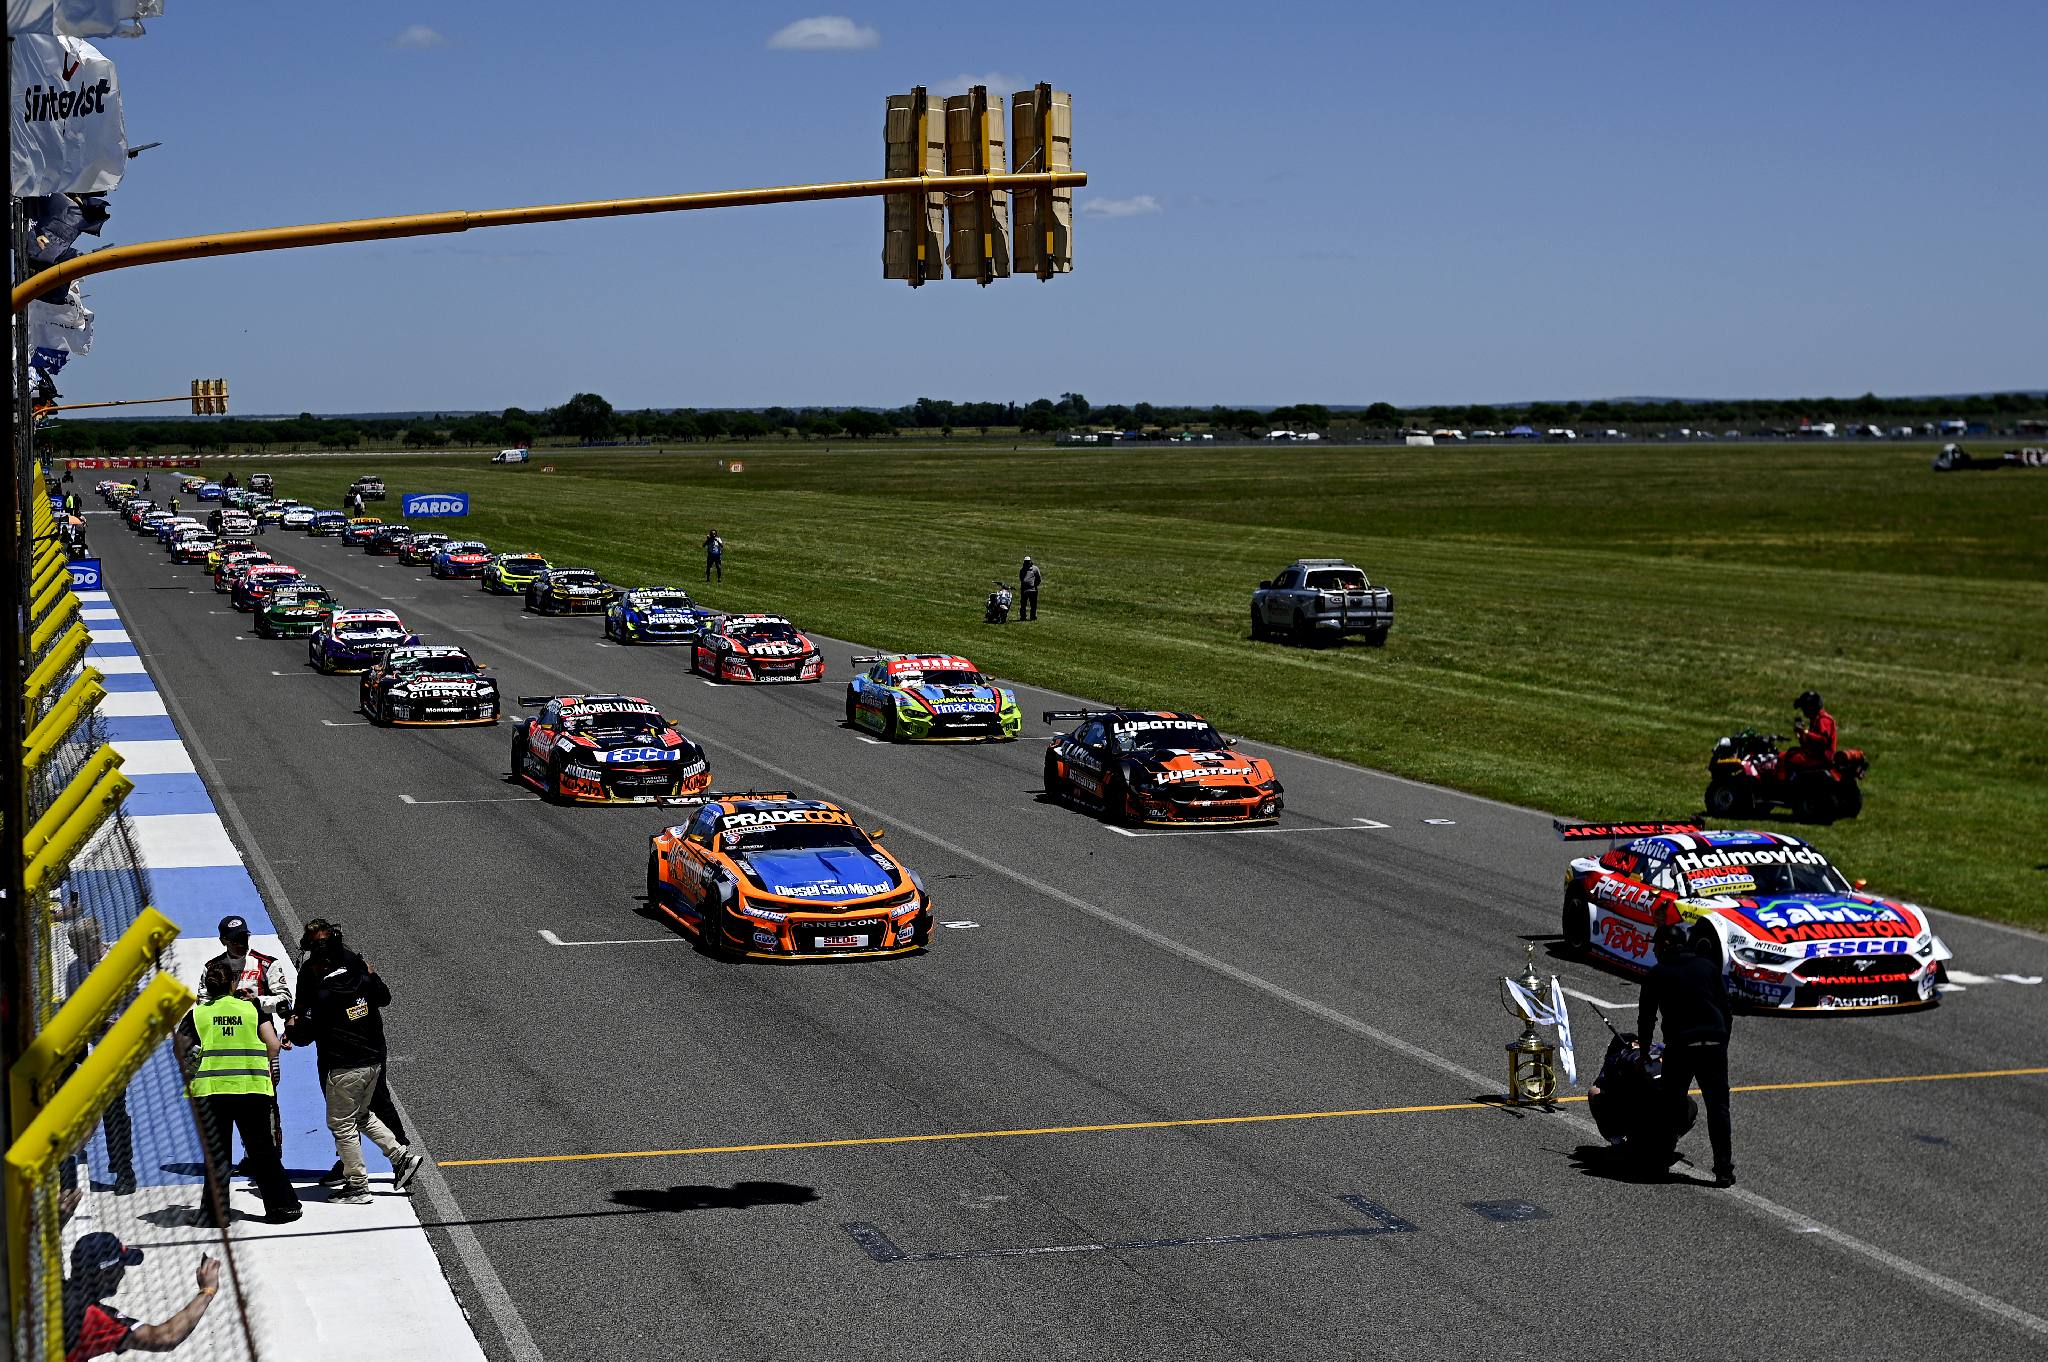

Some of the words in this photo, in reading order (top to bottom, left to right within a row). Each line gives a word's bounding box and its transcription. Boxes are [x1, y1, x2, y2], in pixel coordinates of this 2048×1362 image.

[409, 501, 464, 514] PARDO
[574, 703, 616, 715] MOREL
[606, 748, 677, 763] ESCO
[723, 810, 854, 828] PRADECON
[1675, 846, 1828, 873] Haimovich
[1687, 865, 1748, 881] HAMILTON
[1692, 874, 1753, 888] Salvita
[775, 884, 820, 897] Diesel
[821, 883, 850, 896] San
[851, 881, 891, 897] Miguel
[1771, 920, 1917, 944] HAMILTON
[1755, 941, 1789, 954] INTEGRA
[1804, 940, 1909, 959] ESCO
[213, 1016, 243, 1026] PRENSA
[222, 1027, 235, 1036] 141
